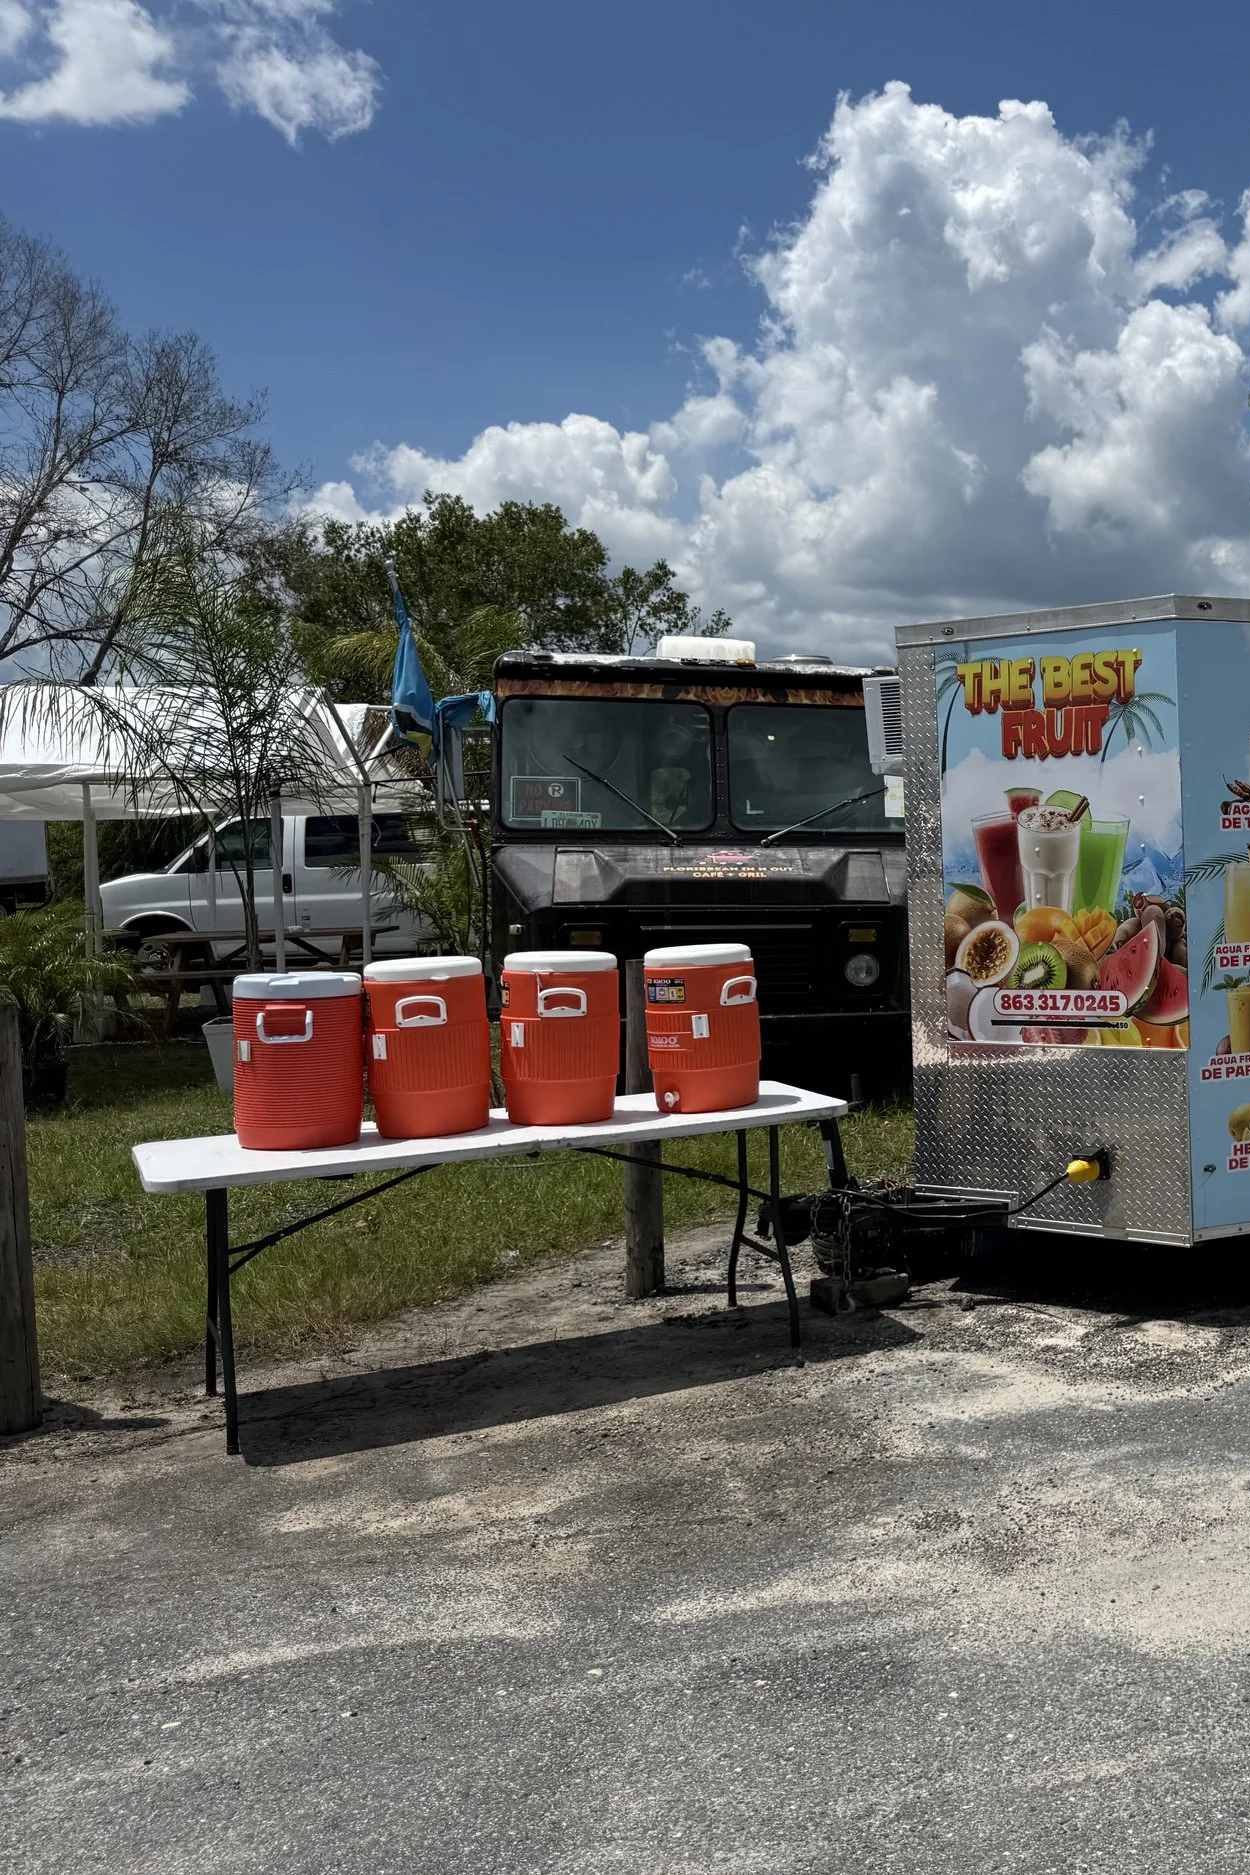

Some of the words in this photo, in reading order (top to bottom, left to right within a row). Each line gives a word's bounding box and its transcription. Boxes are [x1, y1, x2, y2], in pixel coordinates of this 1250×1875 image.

[957, 658, 1035, 714] THE
[1040, 648, 1142, 708] BEST
[1002, 704, 1109, 759] FRUIT
[525, 784, 542, 796] NO
[1222, 817, 1241, 829] DE
[1215, 945, 1246, 955] AGUA
[1219, 956, 1240, 968] DE
[1001, 994, 1120, 1012] 863.317.0245
[1210, 1056, 1237, 1066] AGUA
[1201, 1068, 1222, 1080] DE
[1228, 1158, 1249, 1170] DE
